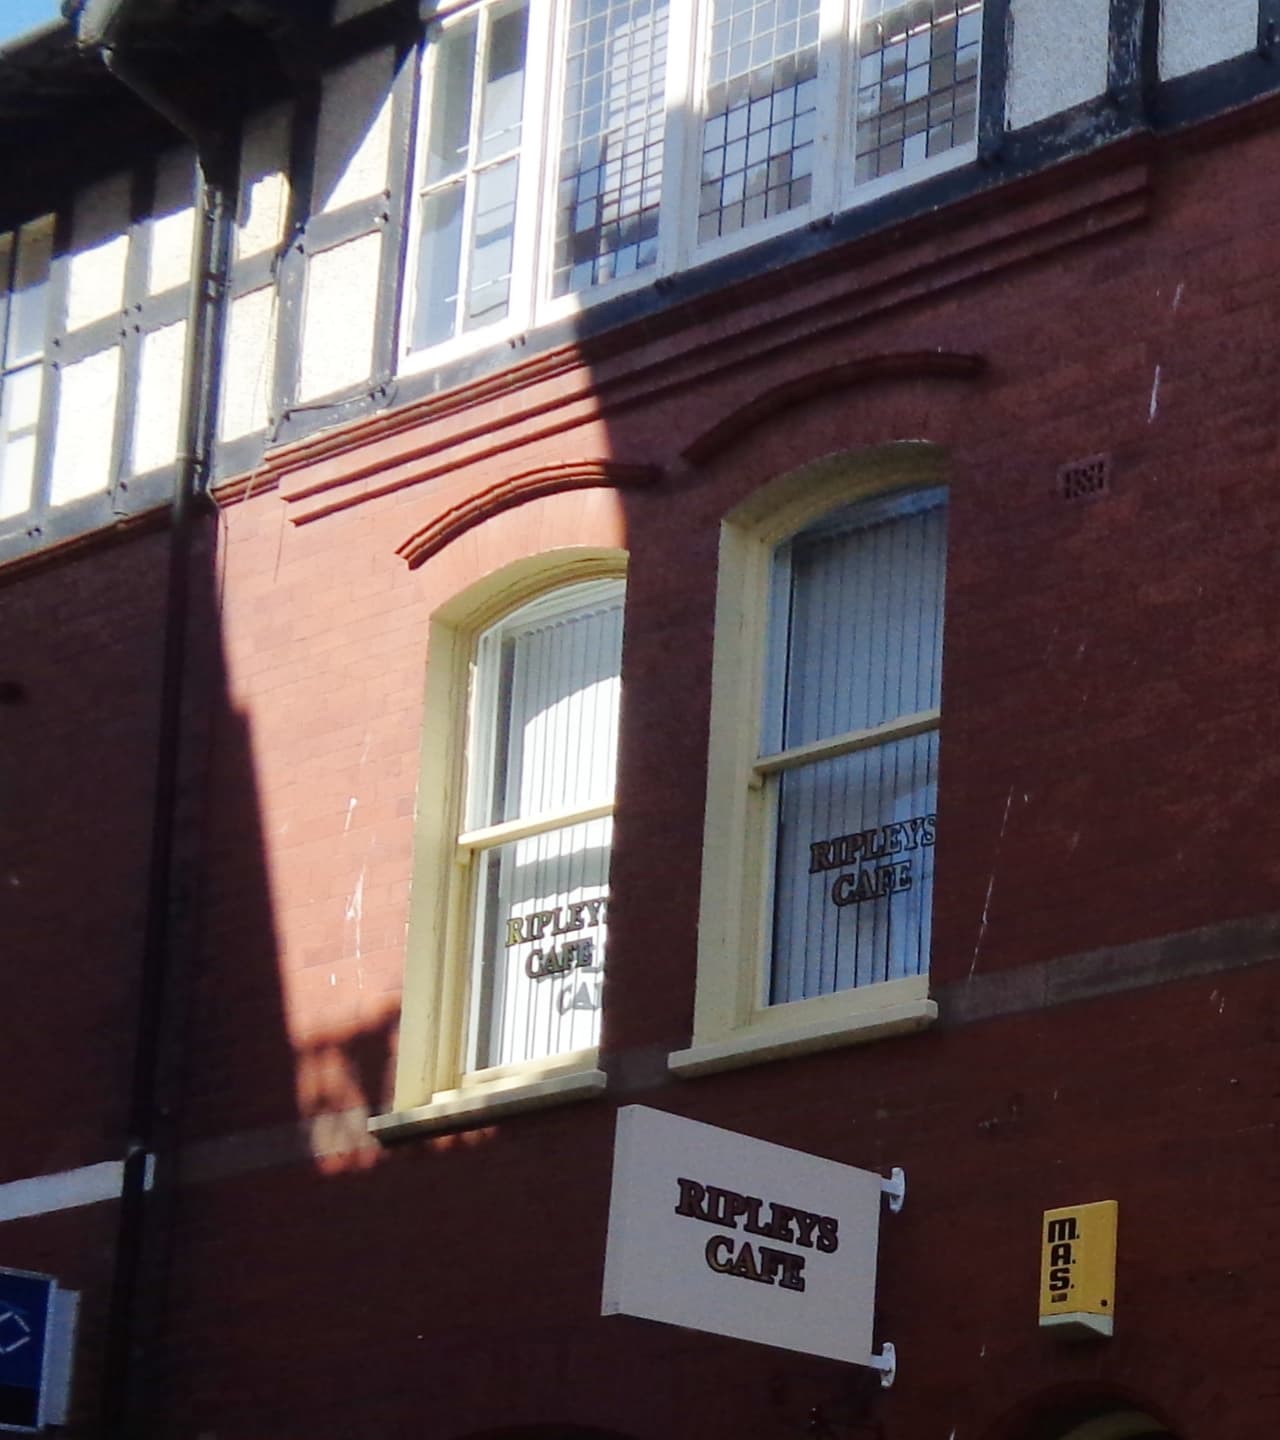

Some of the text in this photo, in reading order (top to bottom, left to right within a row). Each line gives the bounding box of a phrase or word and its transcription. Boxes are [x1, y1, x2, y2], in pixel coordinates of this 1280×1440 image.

[809, 814, 936, 874] RIPLEYS
[832, 860, 912, 907] CAFE
[525, 937, 593, 979] CAFE
[675, 1178, 838, 1253] RIPLEYS
[705, 1235, 805, 1292] CAFE
